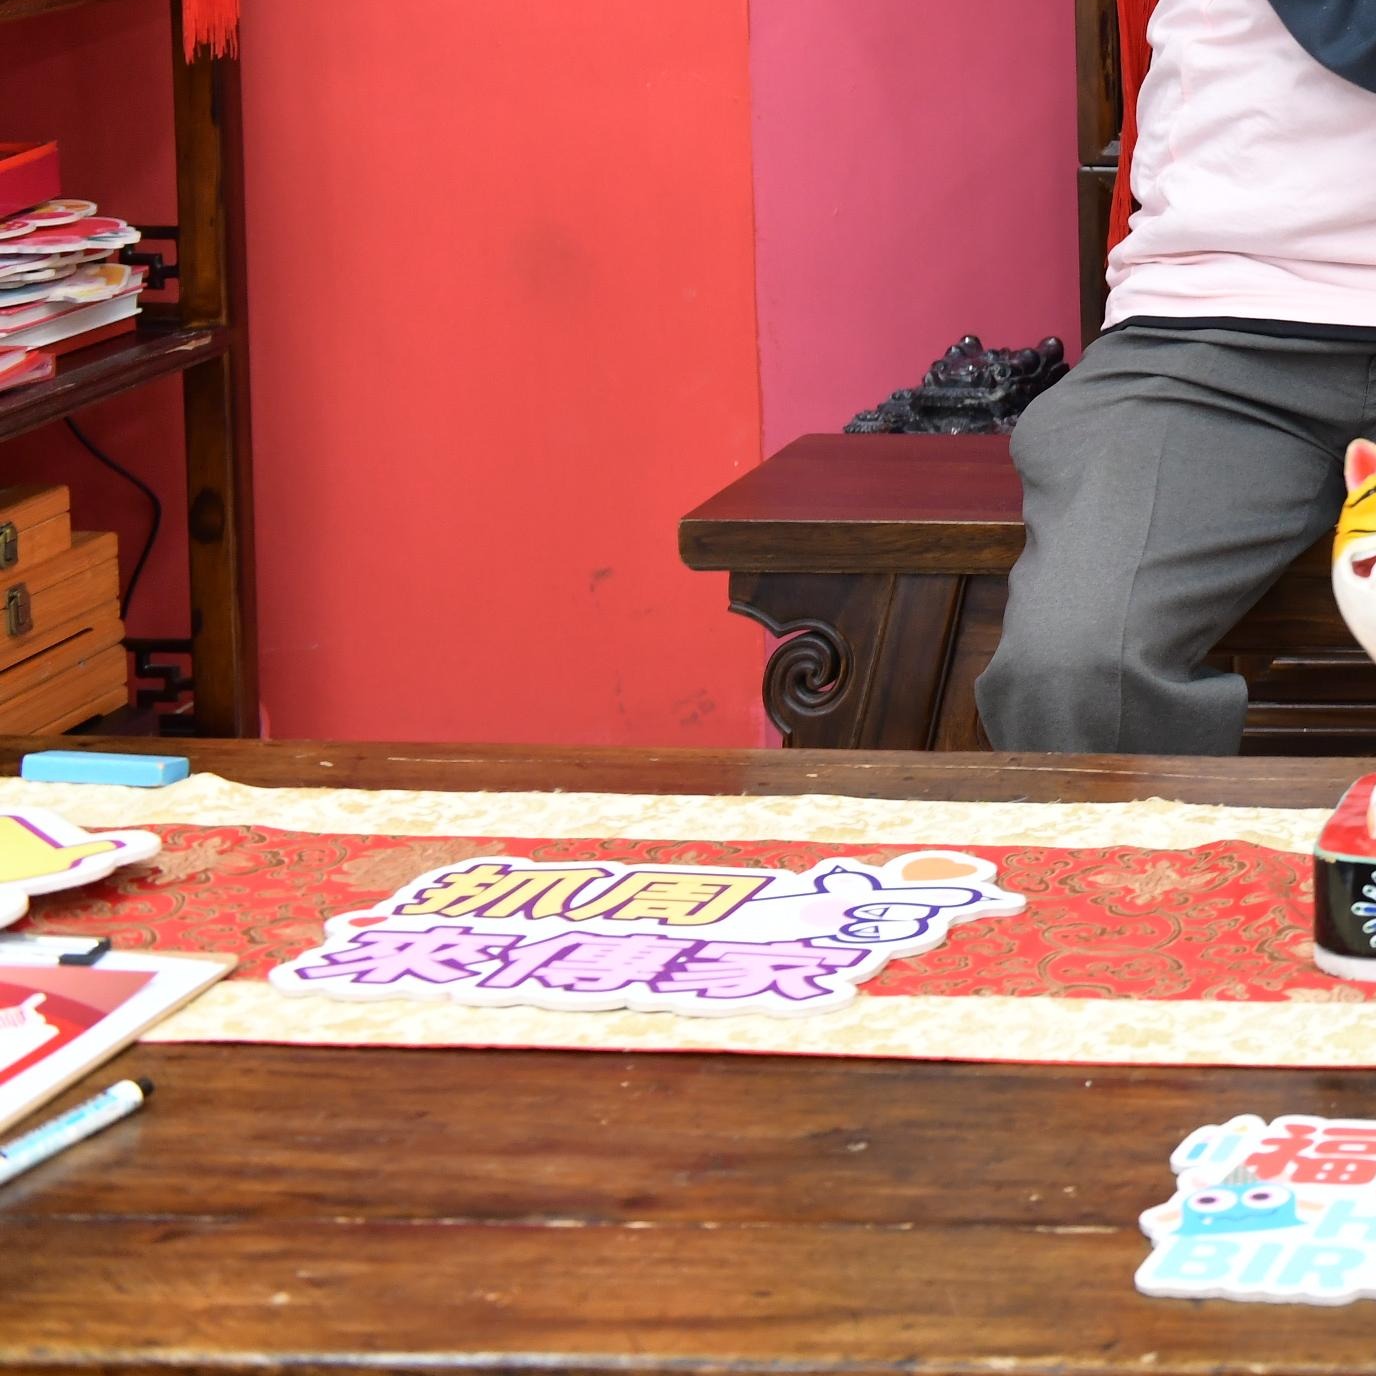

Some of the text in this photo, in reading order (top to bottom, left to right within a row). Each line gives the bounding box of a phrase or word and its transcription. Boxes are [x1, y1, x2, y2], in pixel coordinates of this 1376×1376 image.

[398, 863, 777, 926] 抓周
[294, 925, 870, 1000] 來傳家
